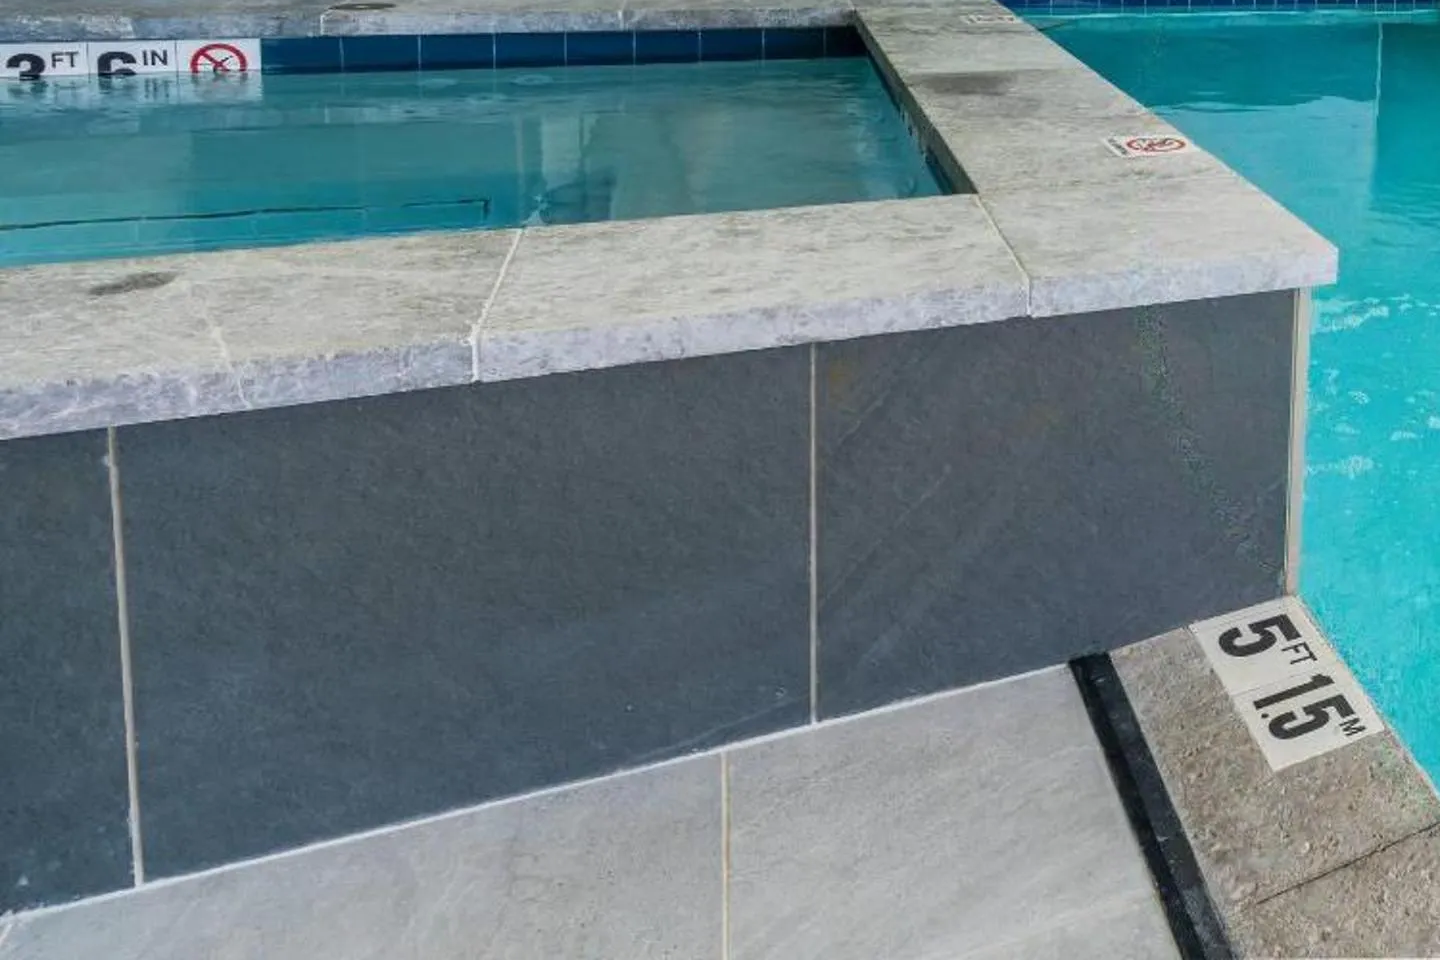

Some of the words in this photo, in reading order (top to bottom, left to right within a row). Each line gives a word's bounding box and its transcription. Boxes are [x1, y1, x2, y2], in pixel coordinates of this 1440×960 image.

[51, 51, 79, 69] FT
[142, 50, 168, 67] IN
[1218, 614, 1303, 658] 5
[1281, 641, 1318, 665] FT
[1338, 717, 1367, 737] M
